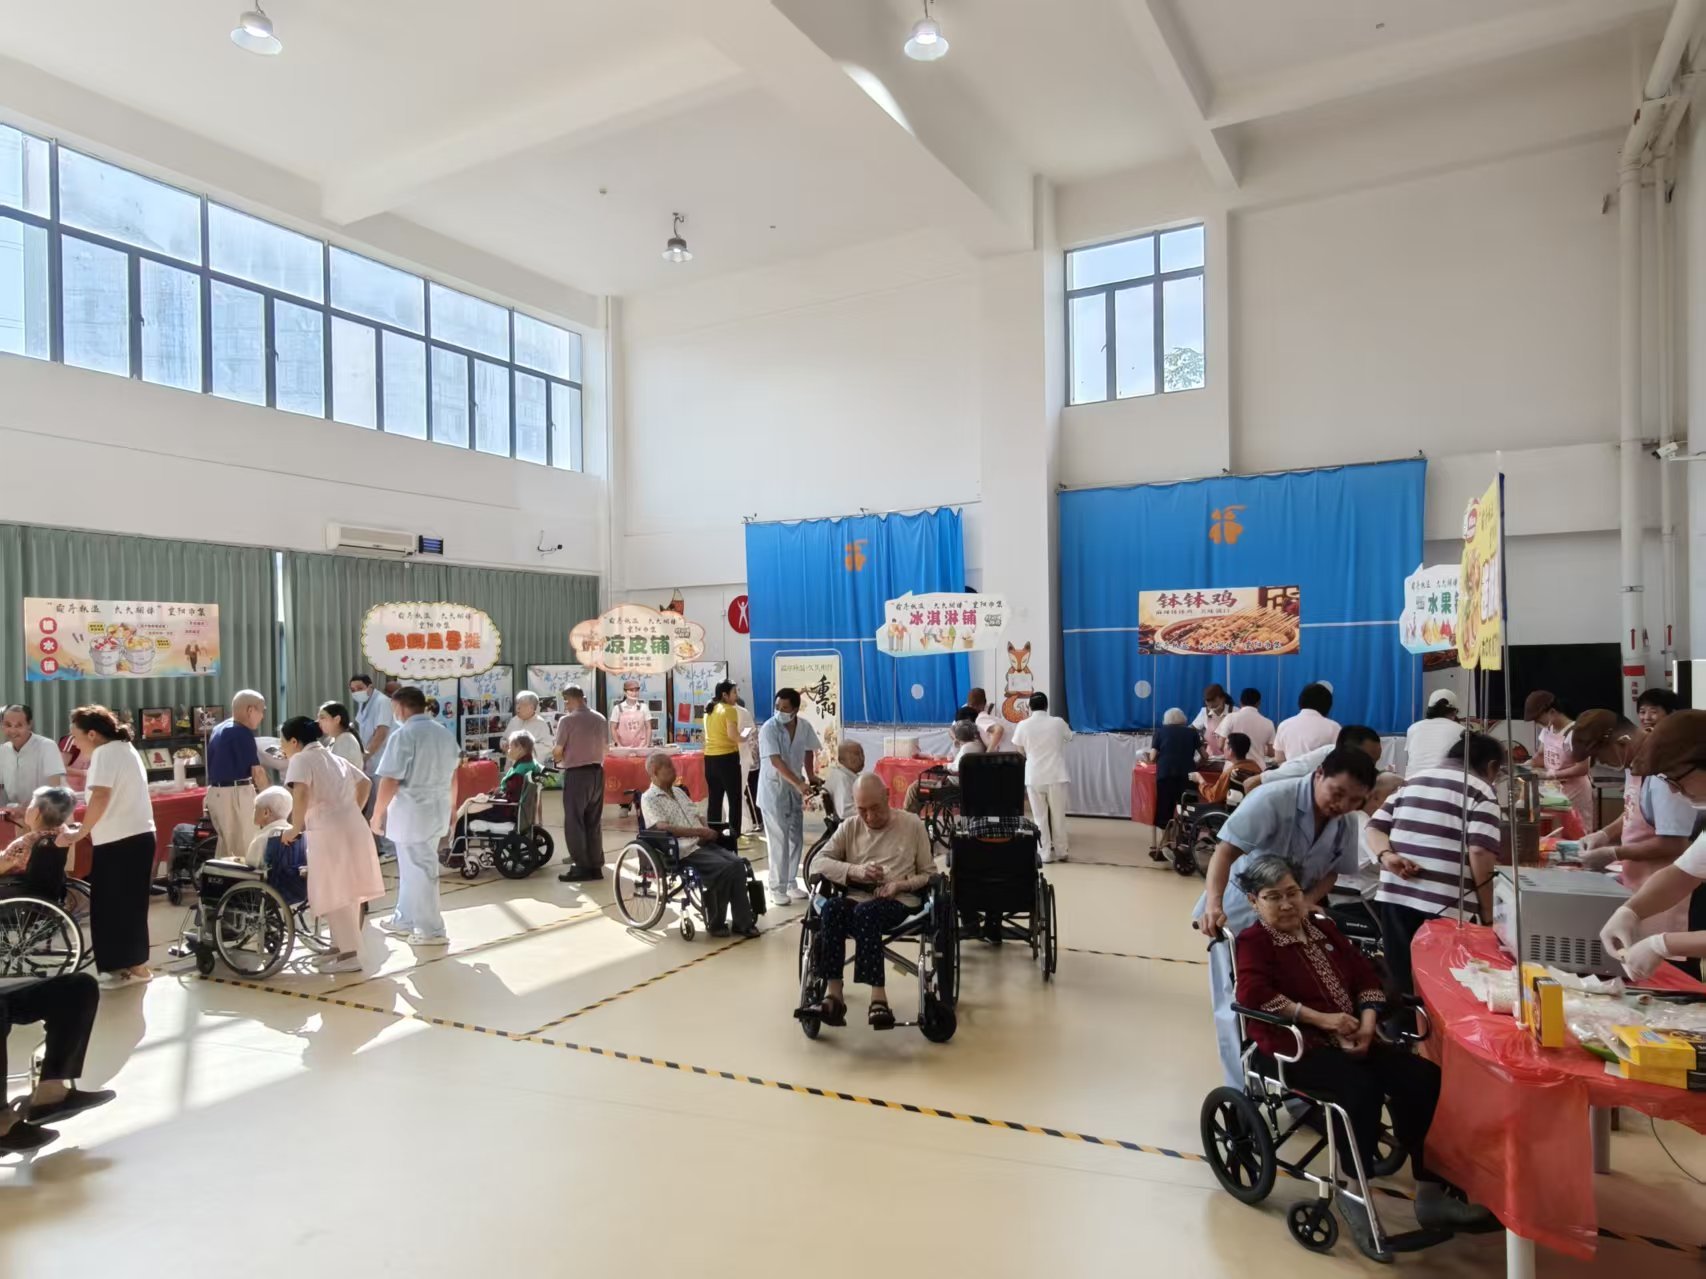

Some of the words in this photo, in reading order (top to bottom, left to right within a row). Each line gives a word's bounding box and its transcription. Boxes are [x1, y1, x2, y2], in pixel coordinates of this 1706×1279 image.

[1156, 589, 1237, 608] 钵钵鸡
[910, 609, 977, 626] 冰淇淋铺
[605, 635, 670, 655] 凉皮铺
[811, 674, 836, 719] 重阳
